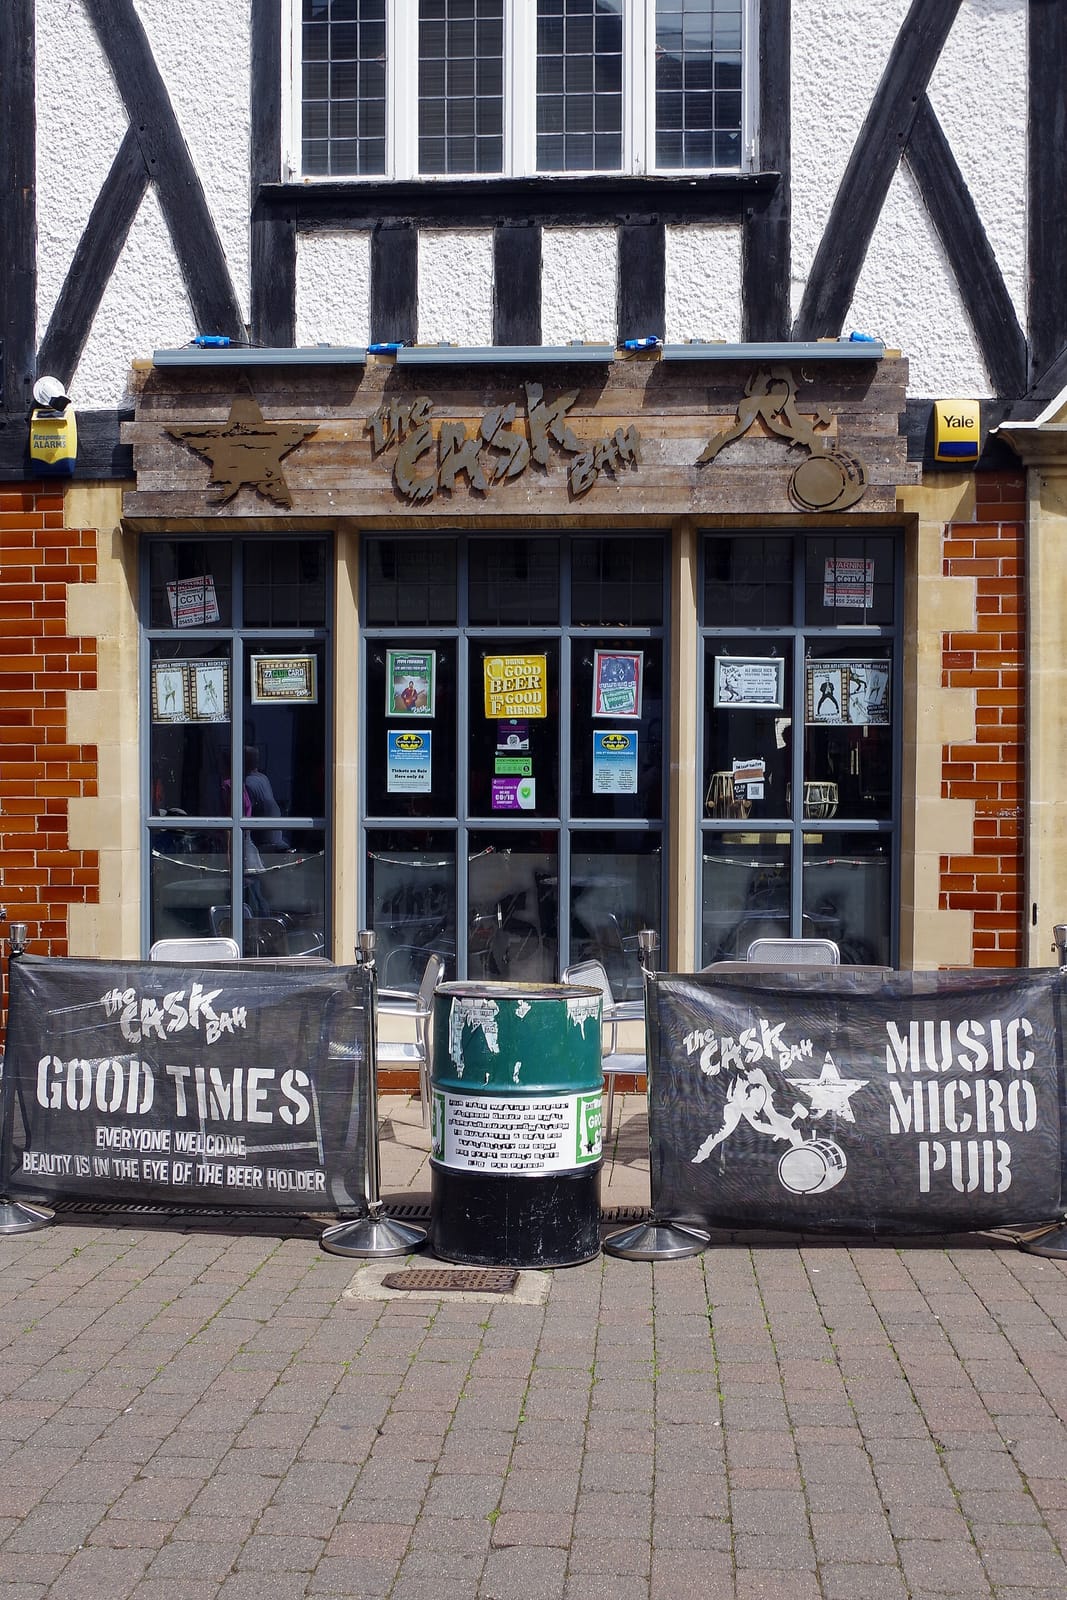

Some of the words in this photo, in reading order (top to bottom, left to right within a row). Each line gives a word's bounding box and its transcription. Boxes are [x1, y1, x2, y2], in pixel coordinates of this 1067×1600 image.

[943, 415, 974, 428] Yale
[394, 381, 584, 499] CASK
[570, 425, 640, 495] BAH
[836, 575, 861, 583] CCTV
[180, 593, 204, 604] CCTV
[288, 669, 304, 677] CARD
[489, 676, 542, 693] BEER
[504, 666, 541, 677] GOOD
[505, 692, 542, 704] GOOD
[119, 983, 224, 1044] CASK
[205, 1006, 247, 1045] BAH
[699, 1018, 786, 1076] CASK
[778, 1038, 813, 1071] BAH
[886, 1018, 1035, 1074] MUSIC
[36, 1055, 155, 1115] GOOD
[166, 1065, 311, 1126] TIMES
[889, 1079, 1037, 1135] MICRO
[96, 1126, 170, 1154] EVERYONE
[174, 1132, 246, 1159] WELCOME
[22, 1153, 72, 1176] BEAUTY
[75, 1155, 90, 1177] IS
[93, 1155, 109, 1178] IN
[112, 1157, 139, 1181] THE
[143, 1159, 168, 1183] EYE
[173, 1161, 193, 1186] OF
[196, 1163, 223, 1187] THE
[227, 1165, 262, 1189] BEER
[267, 1168, 326, 1193] HOLDER
[918, 1140, 1012, 1193] PUB
